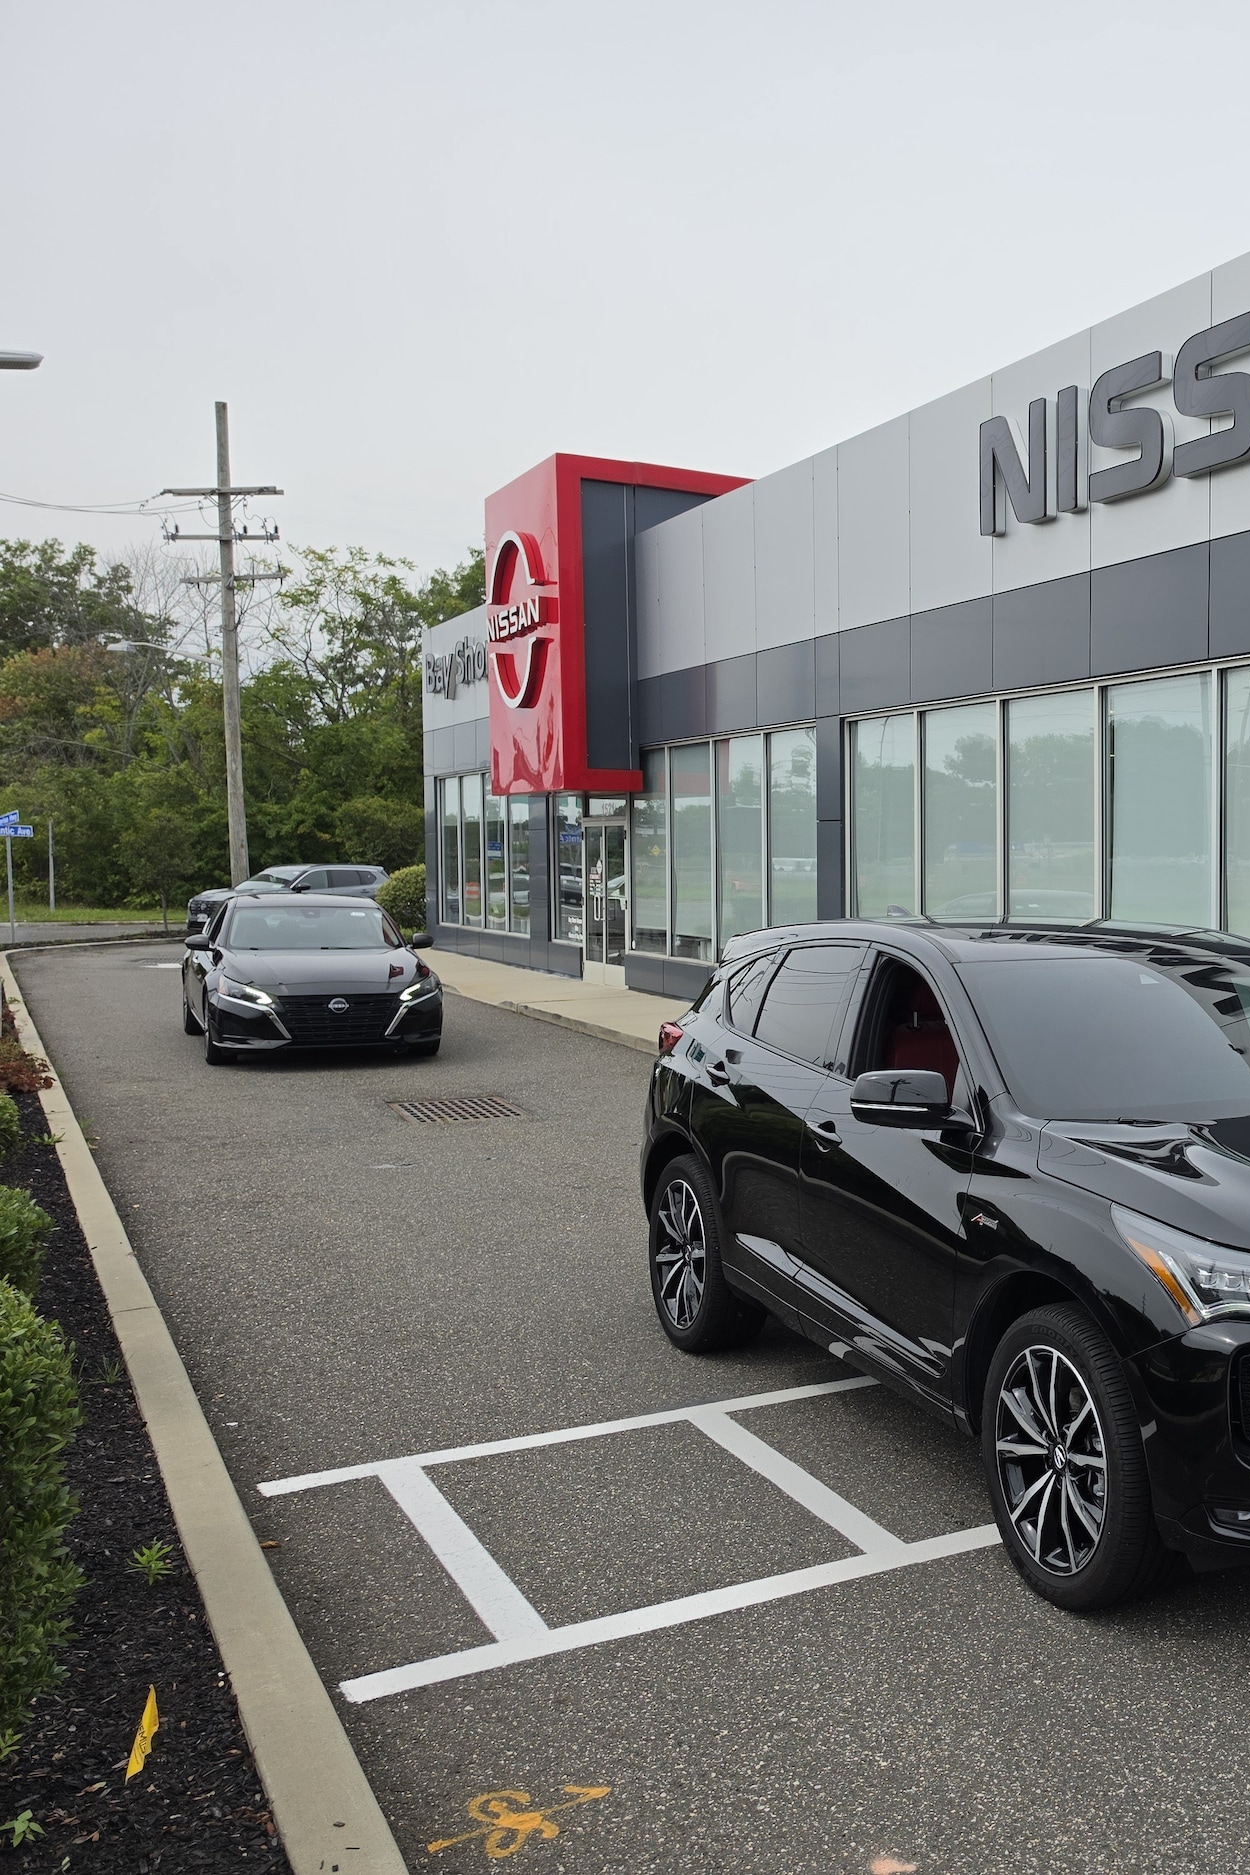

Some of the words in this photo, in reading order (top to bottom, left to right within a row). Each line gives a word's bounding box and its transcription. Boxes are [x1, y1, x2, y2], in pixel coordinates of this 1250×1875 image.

[487, 595, 539, 642] NISSAN
[426, 653, 456, 700] Bay
[455, 636, 488, 685] Sho
